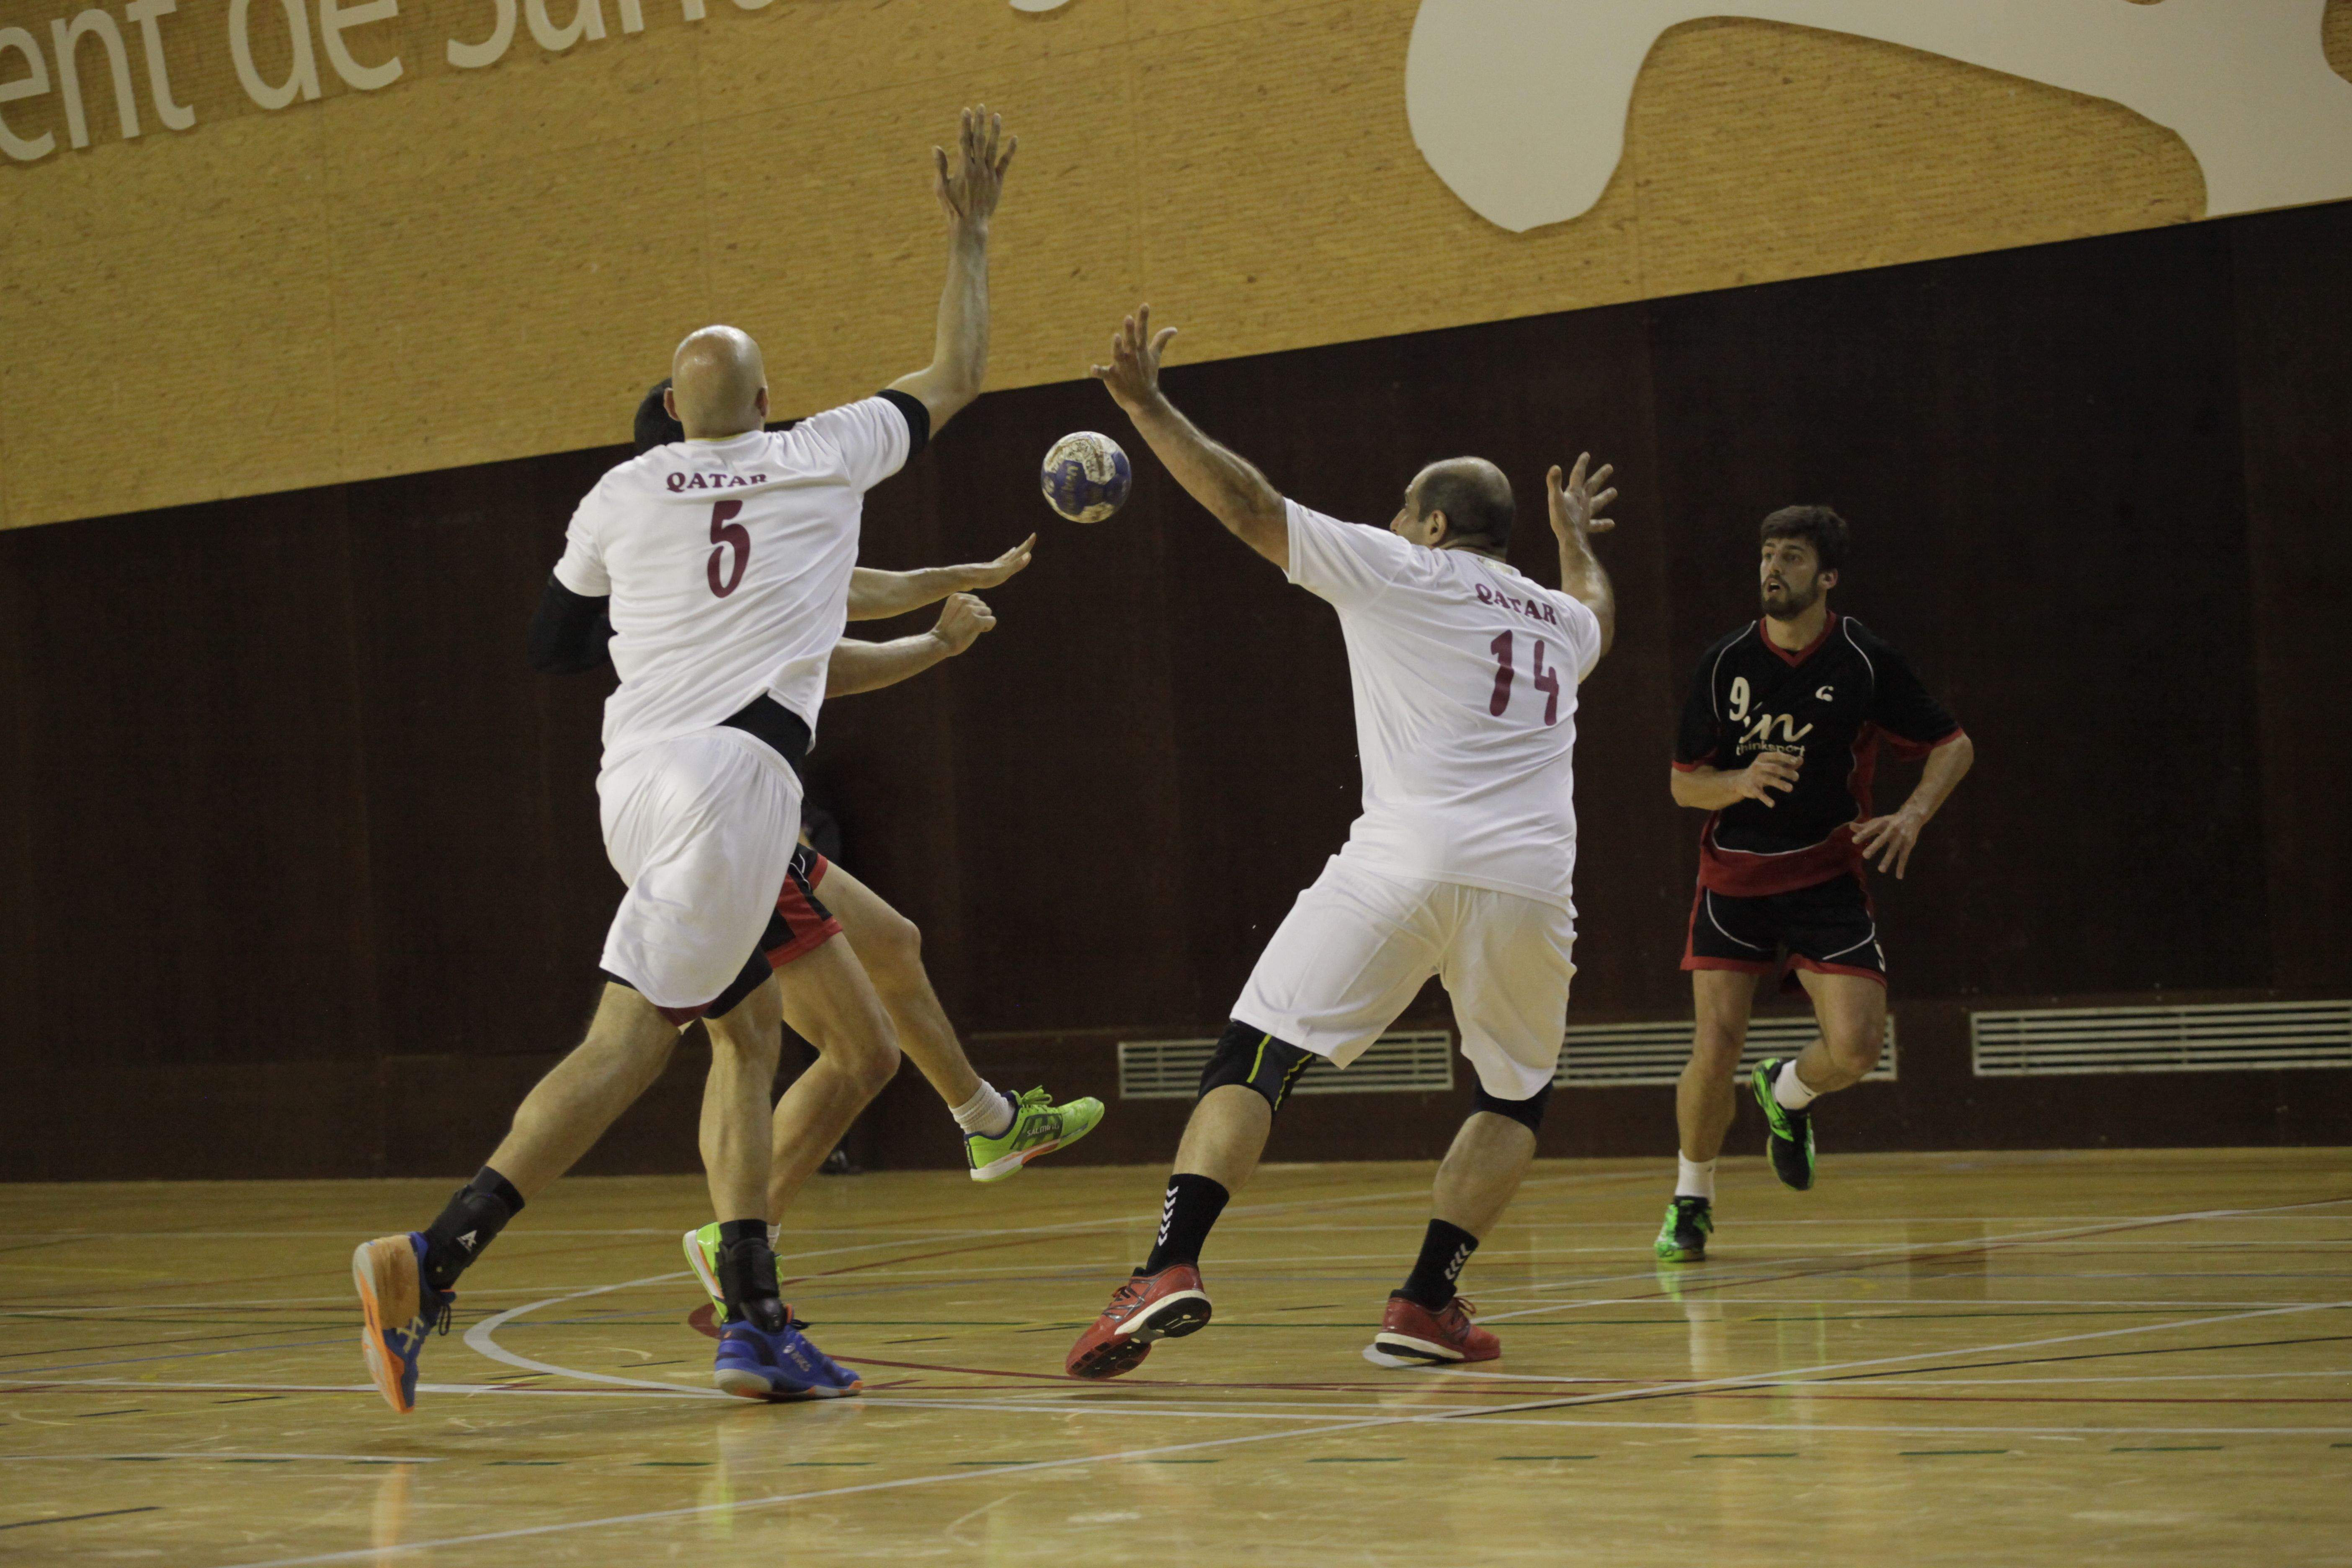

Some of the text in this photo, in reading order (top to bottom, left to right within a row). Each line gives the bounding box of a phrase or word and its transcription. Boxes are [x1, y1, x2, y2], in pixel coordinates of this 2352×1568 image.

[666, 472, 768, 493] QATAR
[707, 500, 750, 598] 5
[1475, 583, 1557, 625] QATAR
[1489, 629, 1559, 726] 14
[1729, 676, 1750, 721] 9
